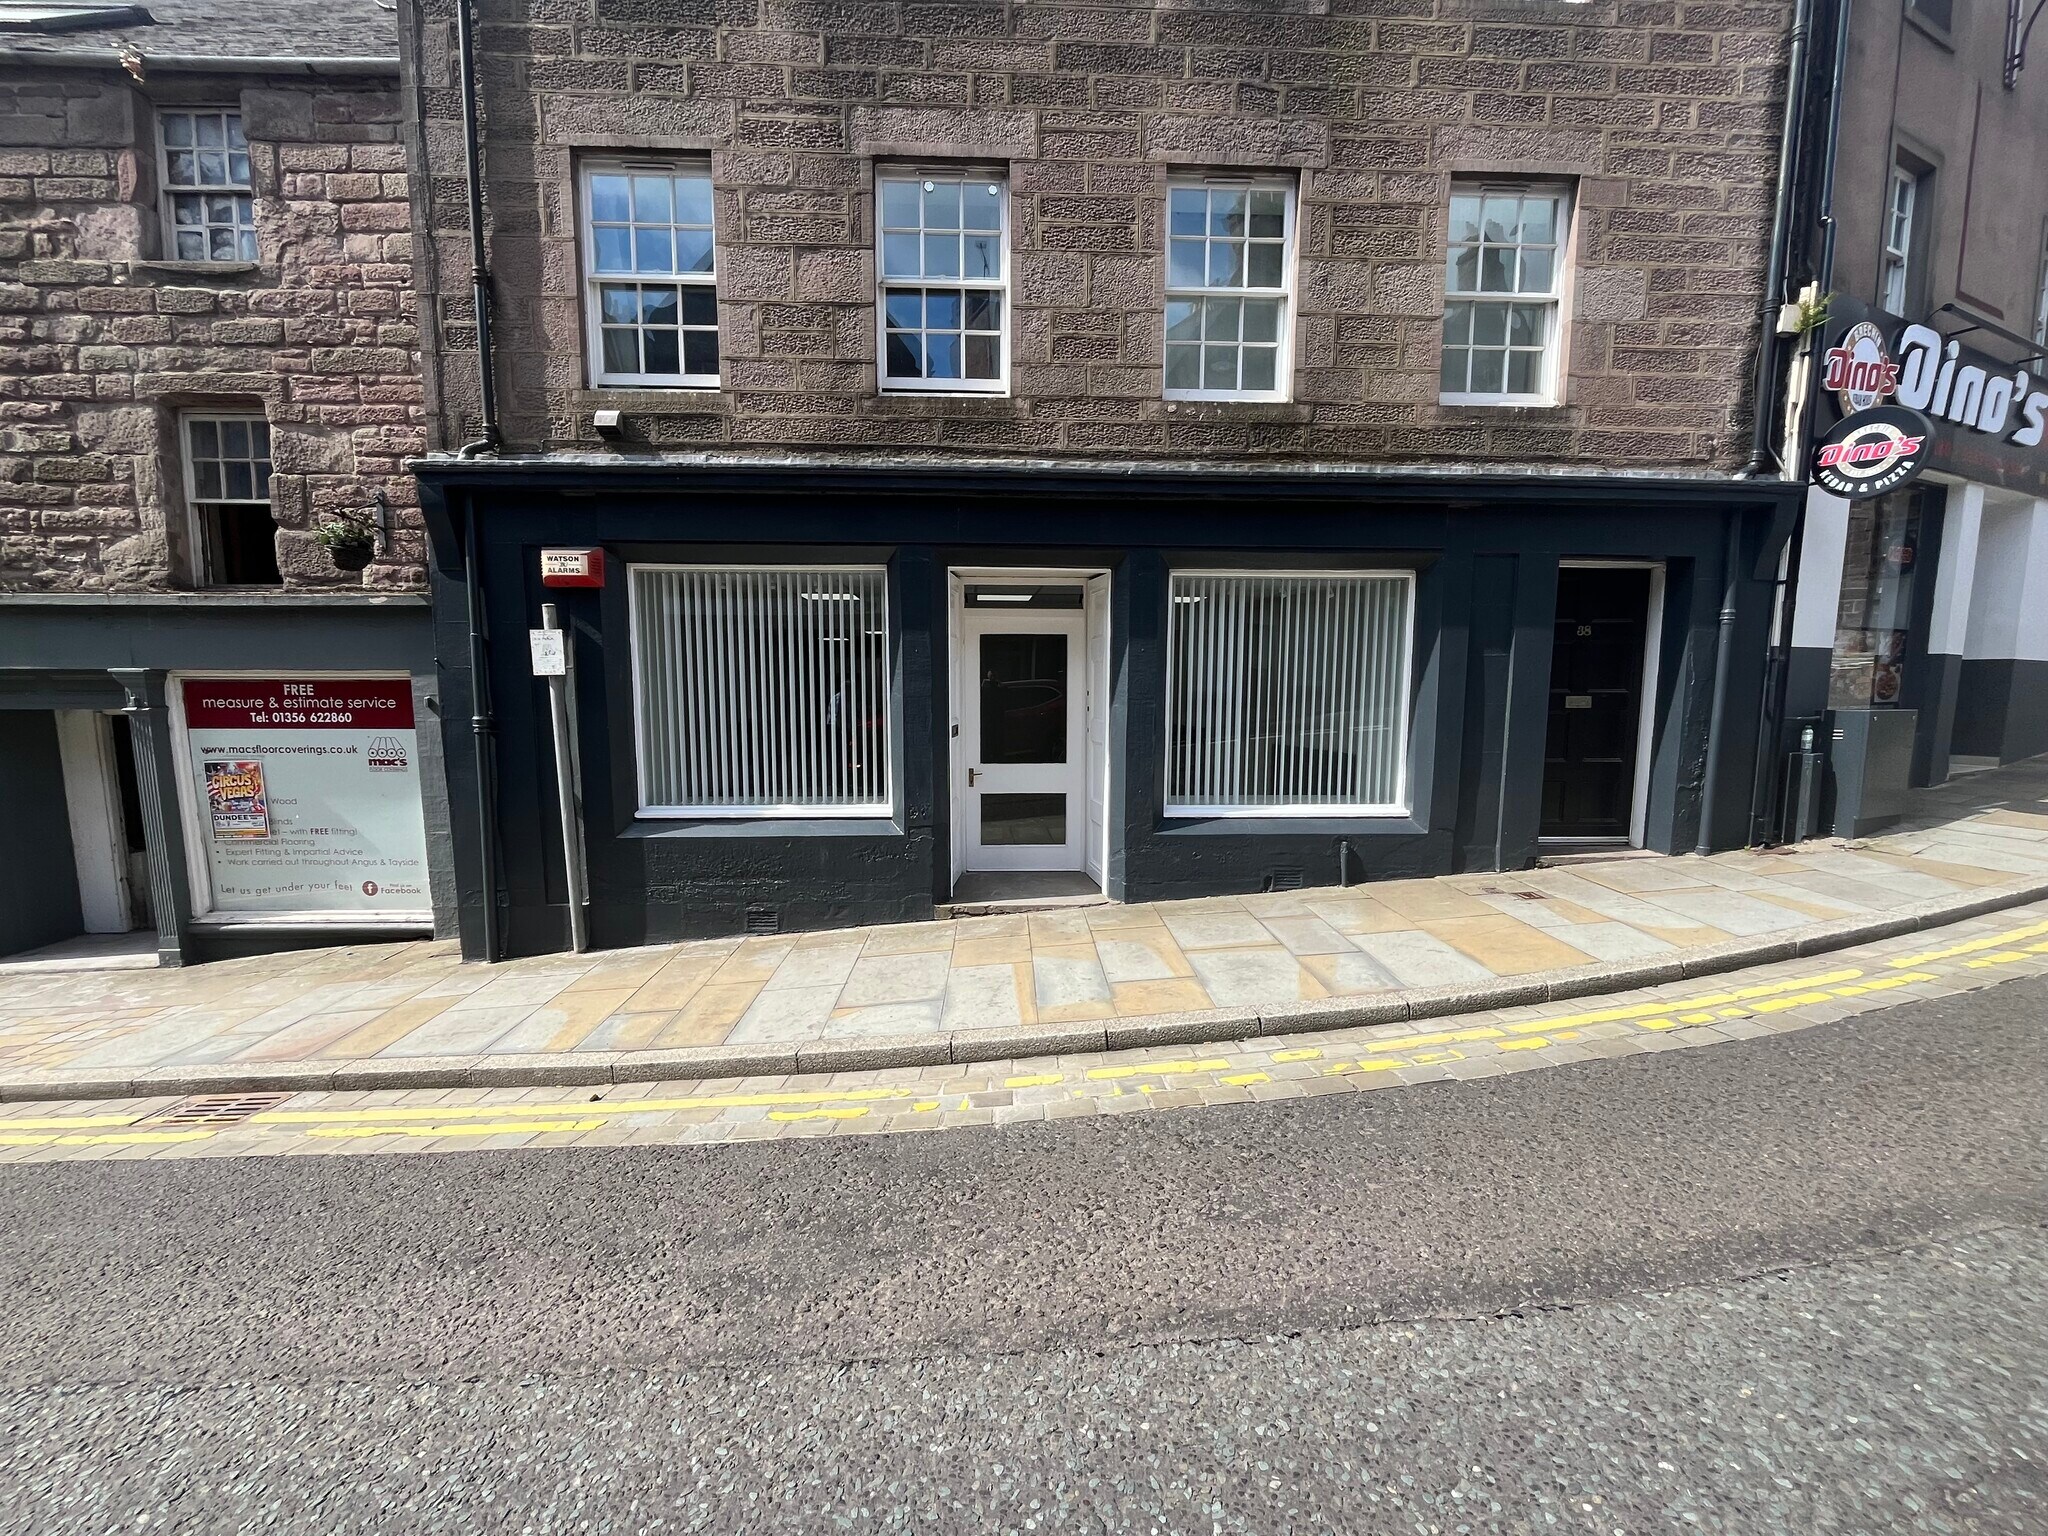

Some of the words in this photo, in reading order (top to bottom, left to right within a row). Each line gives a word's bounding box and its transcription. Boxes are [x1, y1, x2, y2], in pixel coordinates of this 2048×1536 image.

[1823, 347, 1900, 396] Dino's
[1898, 324, 2048, 446] Dino's
[1817, 435, 1926, 466] Dino's
[1819, 469, 1854, 492] KEBAB
[1858, 483, 1868, 493] &
[1874, 461, 1915, 490] PIZZA
[283, 684, 315, 696] FREE
[202, 698, 265, 709] measure
[268, 696, 280, 709] &
[283, 696, 344, 709] estimate
[347, 696, 397, 709] service
[249, 711, 269, 723] Tel:
[272, 712, 306, 723] 01356
[310, 712, 352, 723] 622860
[200, 744, 359, 756] www.macsfloorcoverings.co.uk
[368, 758, 408, 767] mac's
[211, 773, 253, 790] CIRCUS
[219, 785, 255, 802] VEGAS
[271, 797, 298, 805] Wood
[289, 827, 308, 835] with
[310, 828, 330, 836] FREE
[331, 827, 358, 837] fitting)
[281, 838, 316, 847] Flooring
[225, 848, 253, 857] Expert
[255, 848, 281, 857] Fitting
[293, 848, 331, 857] Impartial
[333, 848, 364, 856] Advice
[228, 858, 249, 866] Work
[251, 858, 283, 866] carried
[284, 858, 299, 866] out
[302, 858, 349, 867] throughout
[352, 859, 378, 868] Angus
[380, 858, 386, 866] &
[388, 858, 419, 867] Tayside
[220, 883, 235, 894] Let
[255, 886, 271, 897] get
[275, 881, 304, 893] under
[308, 881, 330, 892] your
[334, 879, 353, 892] feet
